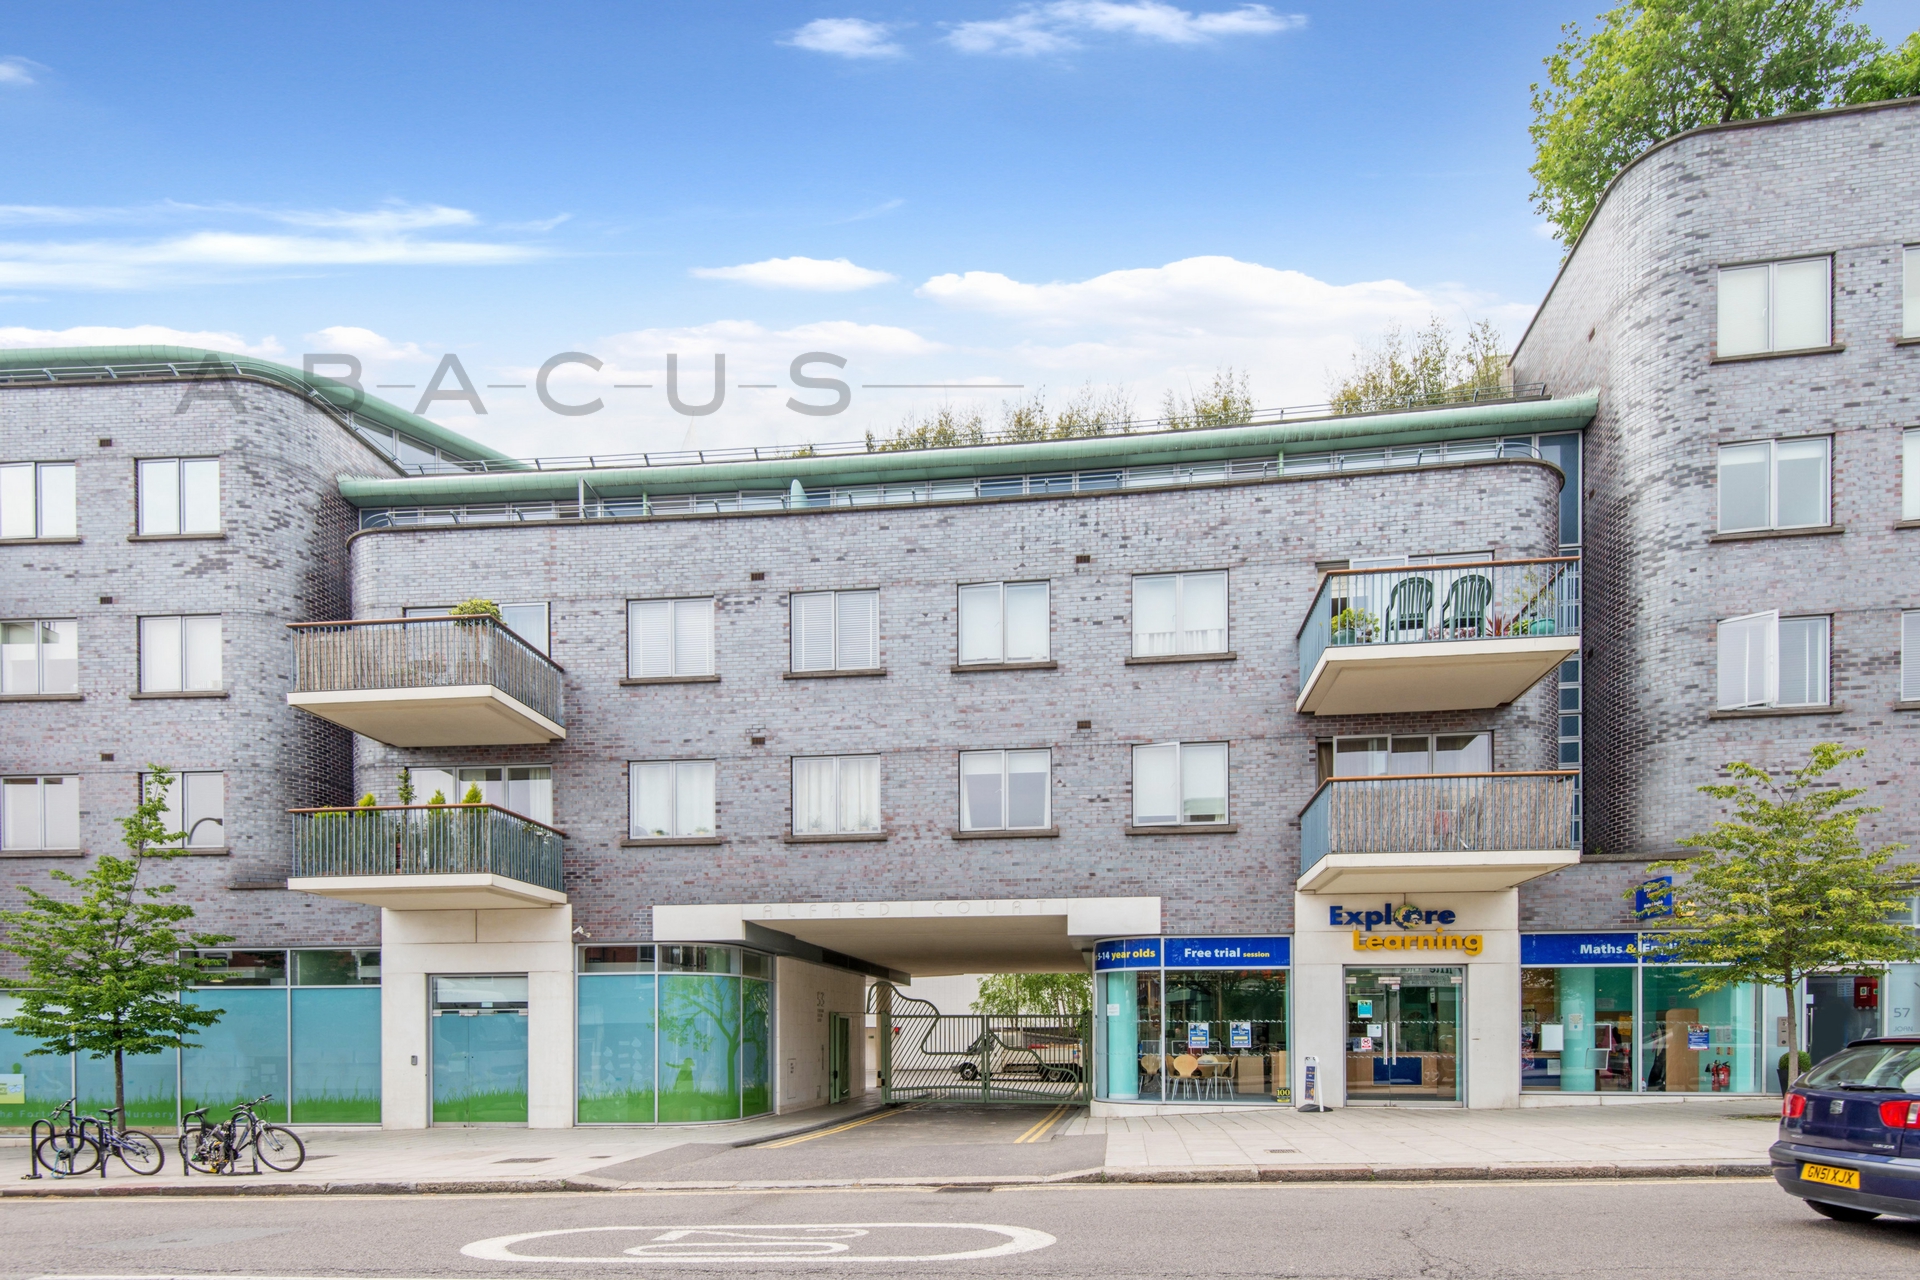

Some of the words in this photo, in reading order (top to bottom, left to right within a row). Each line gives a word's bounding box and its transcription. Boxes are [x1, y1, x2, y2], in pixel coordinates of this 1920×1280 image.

[763, 903, 890, 918] ALFRED
[933, 900, 1047, 915] COURT
[1329, 903, 1456, 931] Explore
[1352, 927, 1483, 956] Learning
[1580, 943, 1623, 954] Maths
[1626, 943, 1637, 954] &
[1111, 950, 1131, 961] year
[1132, 948, 1156, 958] olds
[1184, 948, 1212, 958] Free
[1213, 947, 1241, 958] trial
[817, 991, 825, 1007] 53
[1893, 1008, 1911, 1018] 57
[0, 1110, 13, 1118] he
[20, 1110, 69, 1118] Forte
[124, 1110, 175, 1120] Nursery
[1807, 1165, 1831, 1181] GN51
[1831, 1169, 1855, 1185] XJX
